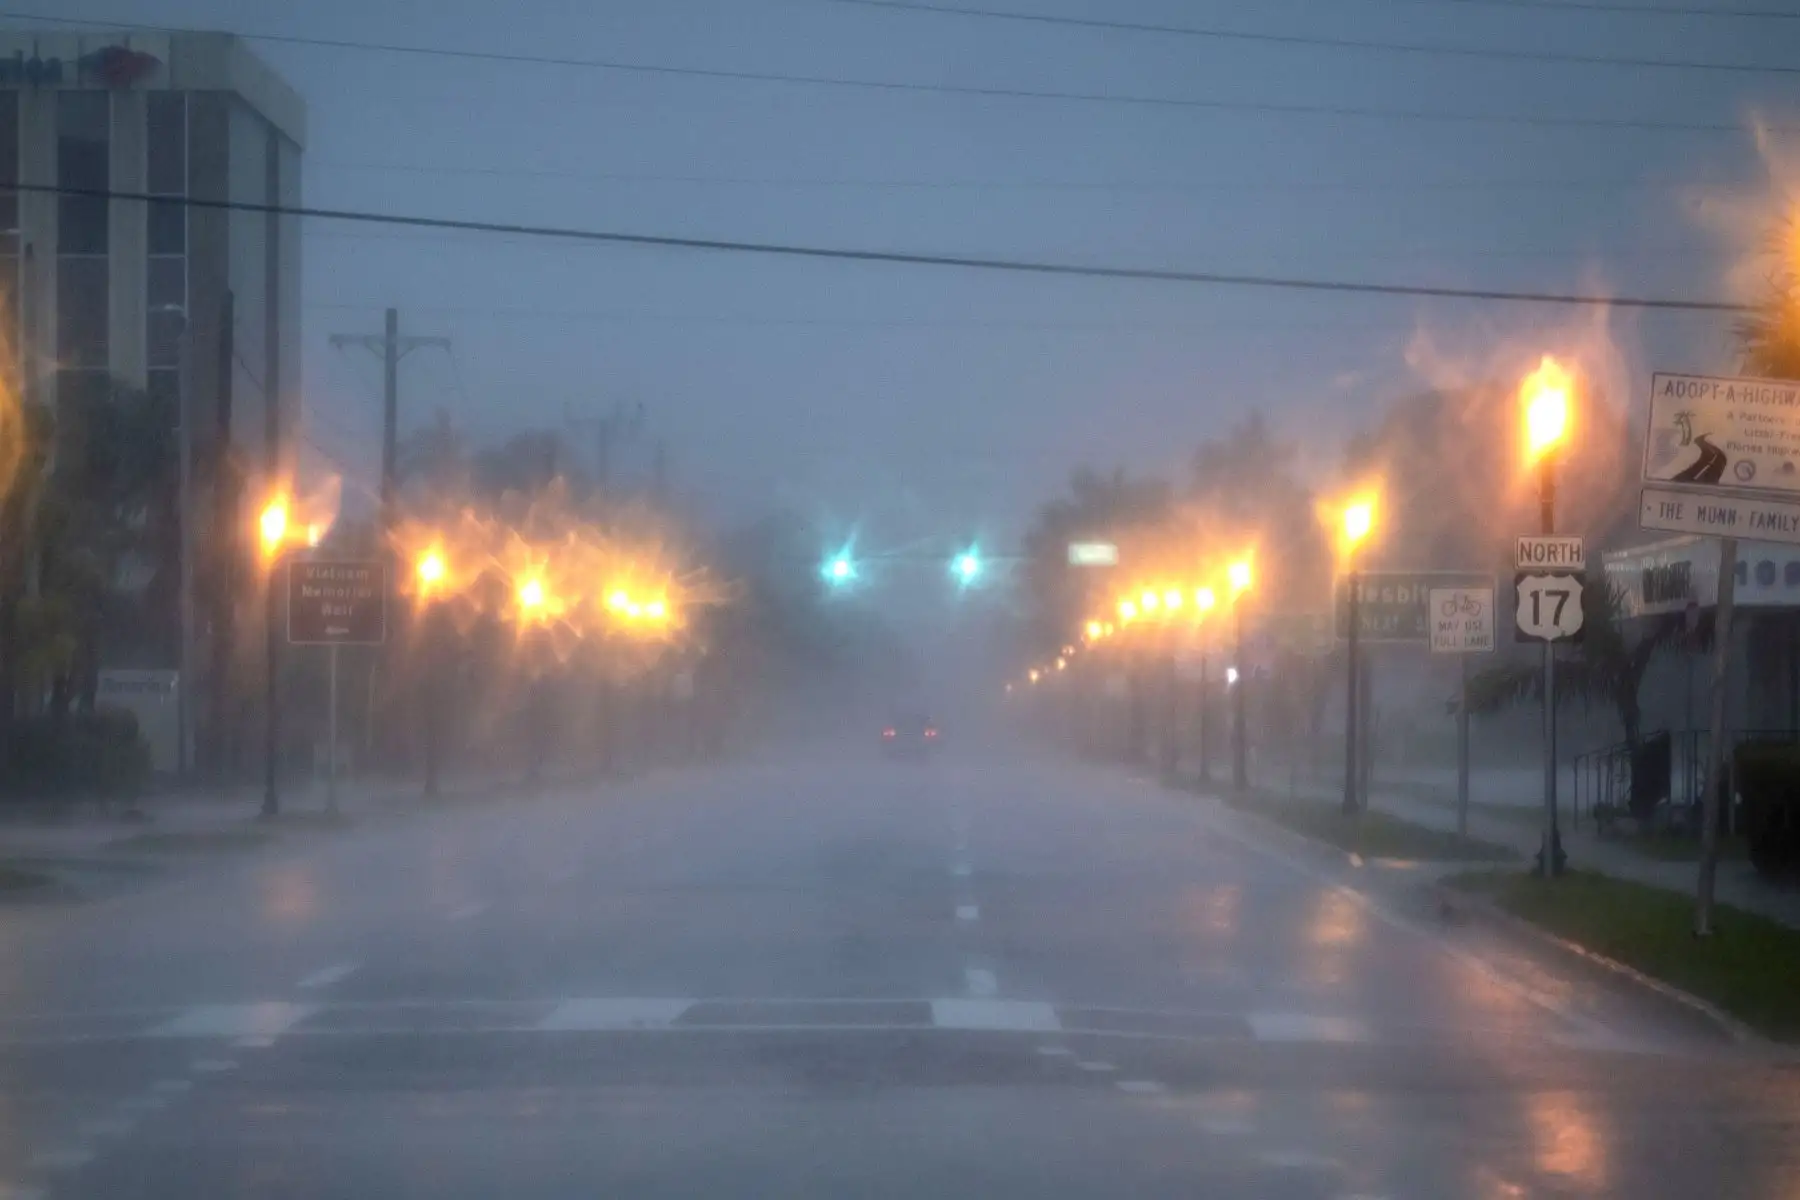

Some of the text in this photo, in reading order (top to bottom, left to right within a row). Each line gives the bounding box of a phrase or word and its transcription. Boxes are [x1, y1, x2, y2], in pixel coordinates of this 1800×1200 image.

[1664, 380, 1800, 407] ADOPT-A-HIGHW
[1659, 502, 1799, 532] THE MUNN FAMILY
[1520, 543, 1581, 562] NORTH
[305, 566, 369, 581] Vietnam
[302, 584, 371, 599] Memorial
[321, 602, 353, 617] Wall
[1530, 590, 1570, 626] 17
[1438, 620, 1460, 632] MAY
[1465, 620, 1482, 632] USE
[1434, 635, 1489, 648] FULL LANE
